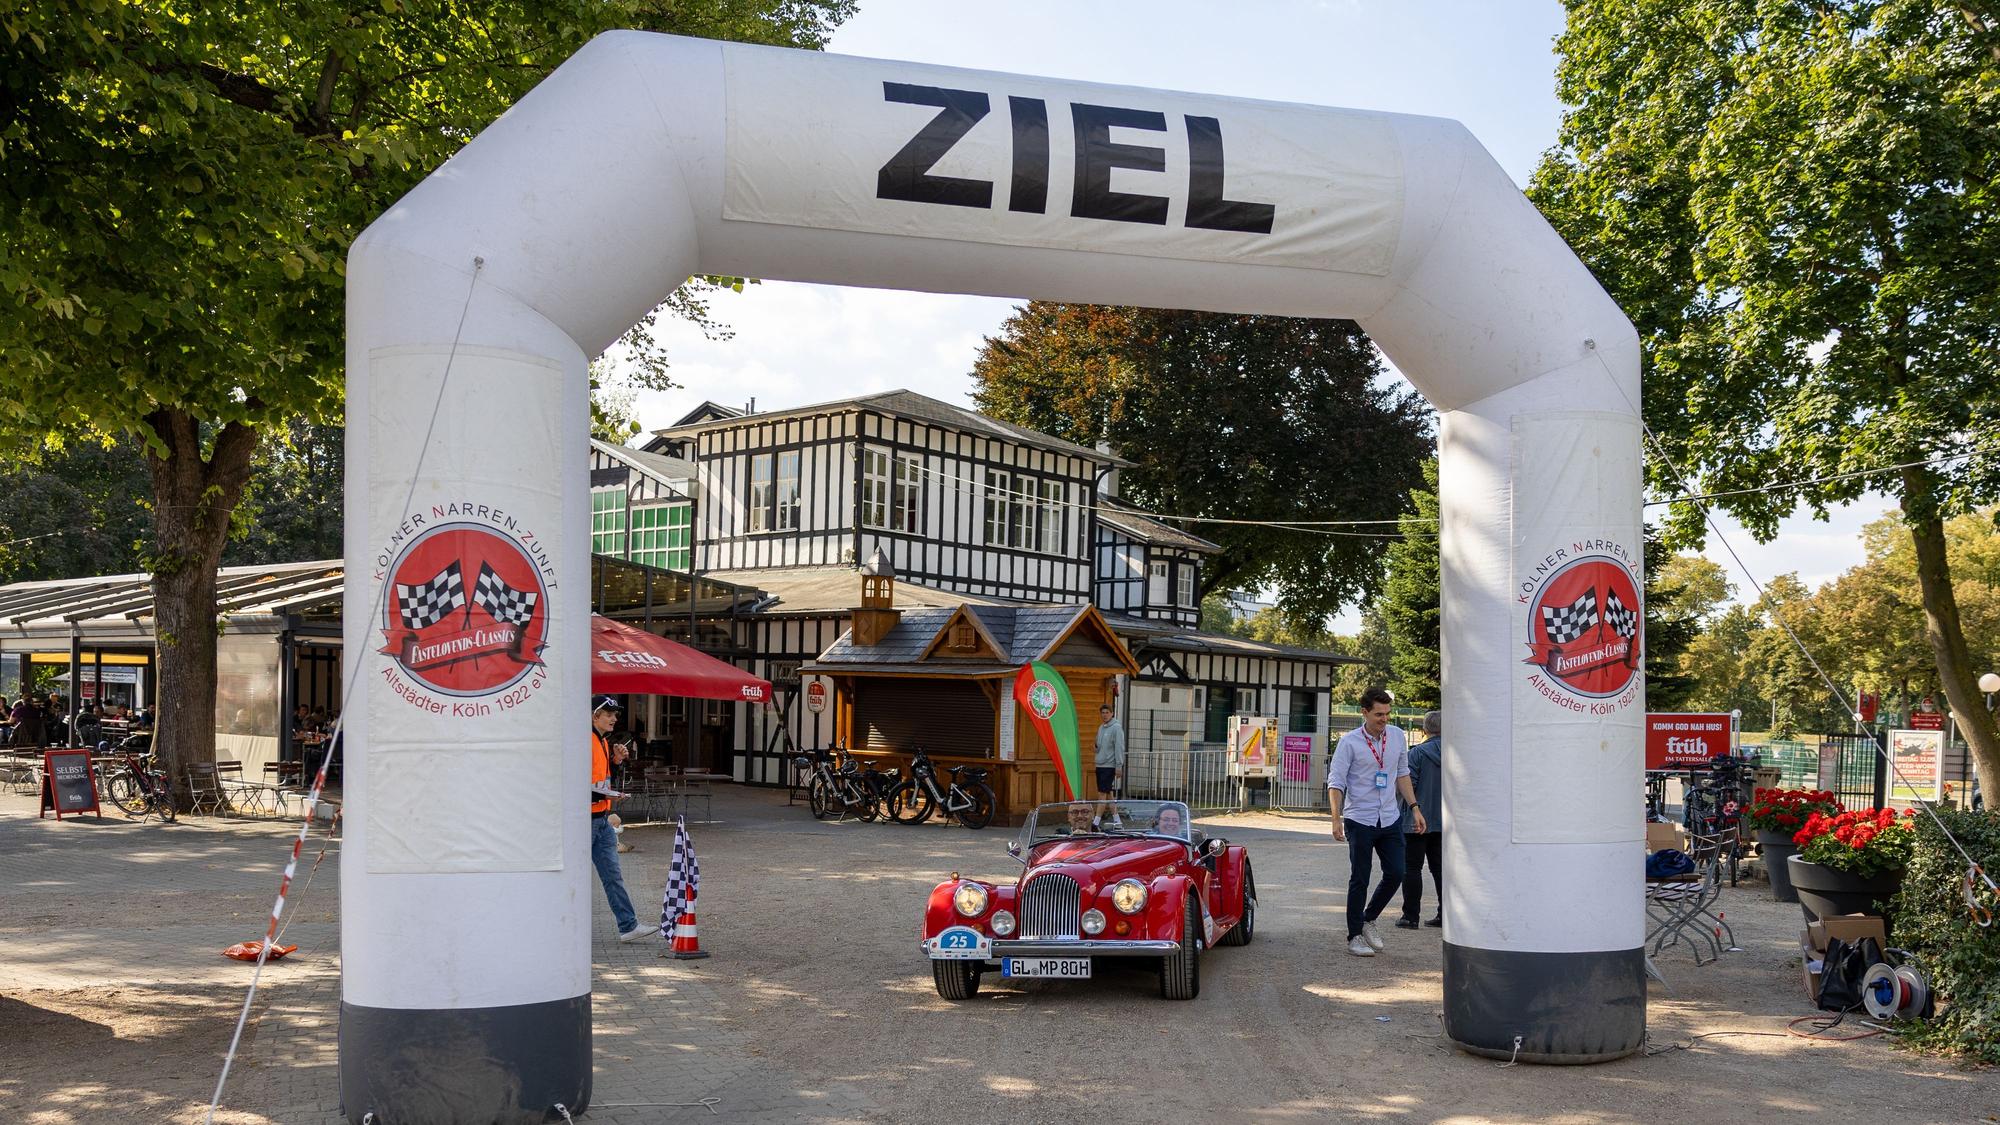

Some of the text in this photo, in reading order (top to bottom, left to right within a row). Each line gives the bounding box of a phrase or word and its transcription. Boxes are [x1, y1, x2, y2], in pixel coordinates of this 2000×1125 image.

[876, 81, 1276, 234] ZIEL
[374, 502, 558, 590] KÖLNER NARREN-ZUNFT
[1517, 548, 1568, 604] KÖLNER
[597, 650, 668, 668] früh
[381, 667, 448, 715] Altstädter
[452, 702, 490, 718] Köln
[495, 685, 532, 711] 1922
[741, 685, 763, 698] früh
[1527, 673, 1586, 713] Altstädter
[1590, 703, 1615, 715] Köln
[1617, 687, 1636, 709] 1922
[1652, 722, 1674, 731] KOMM
[1690, 723, 1705, 731] NAH
[1706, 723, 1722, 731] HUS!
[1665, 736, 1708, 757] früh
[949, 935, 968, 948] 25
[1011, 960, 1089, 976] GL MP 80H
